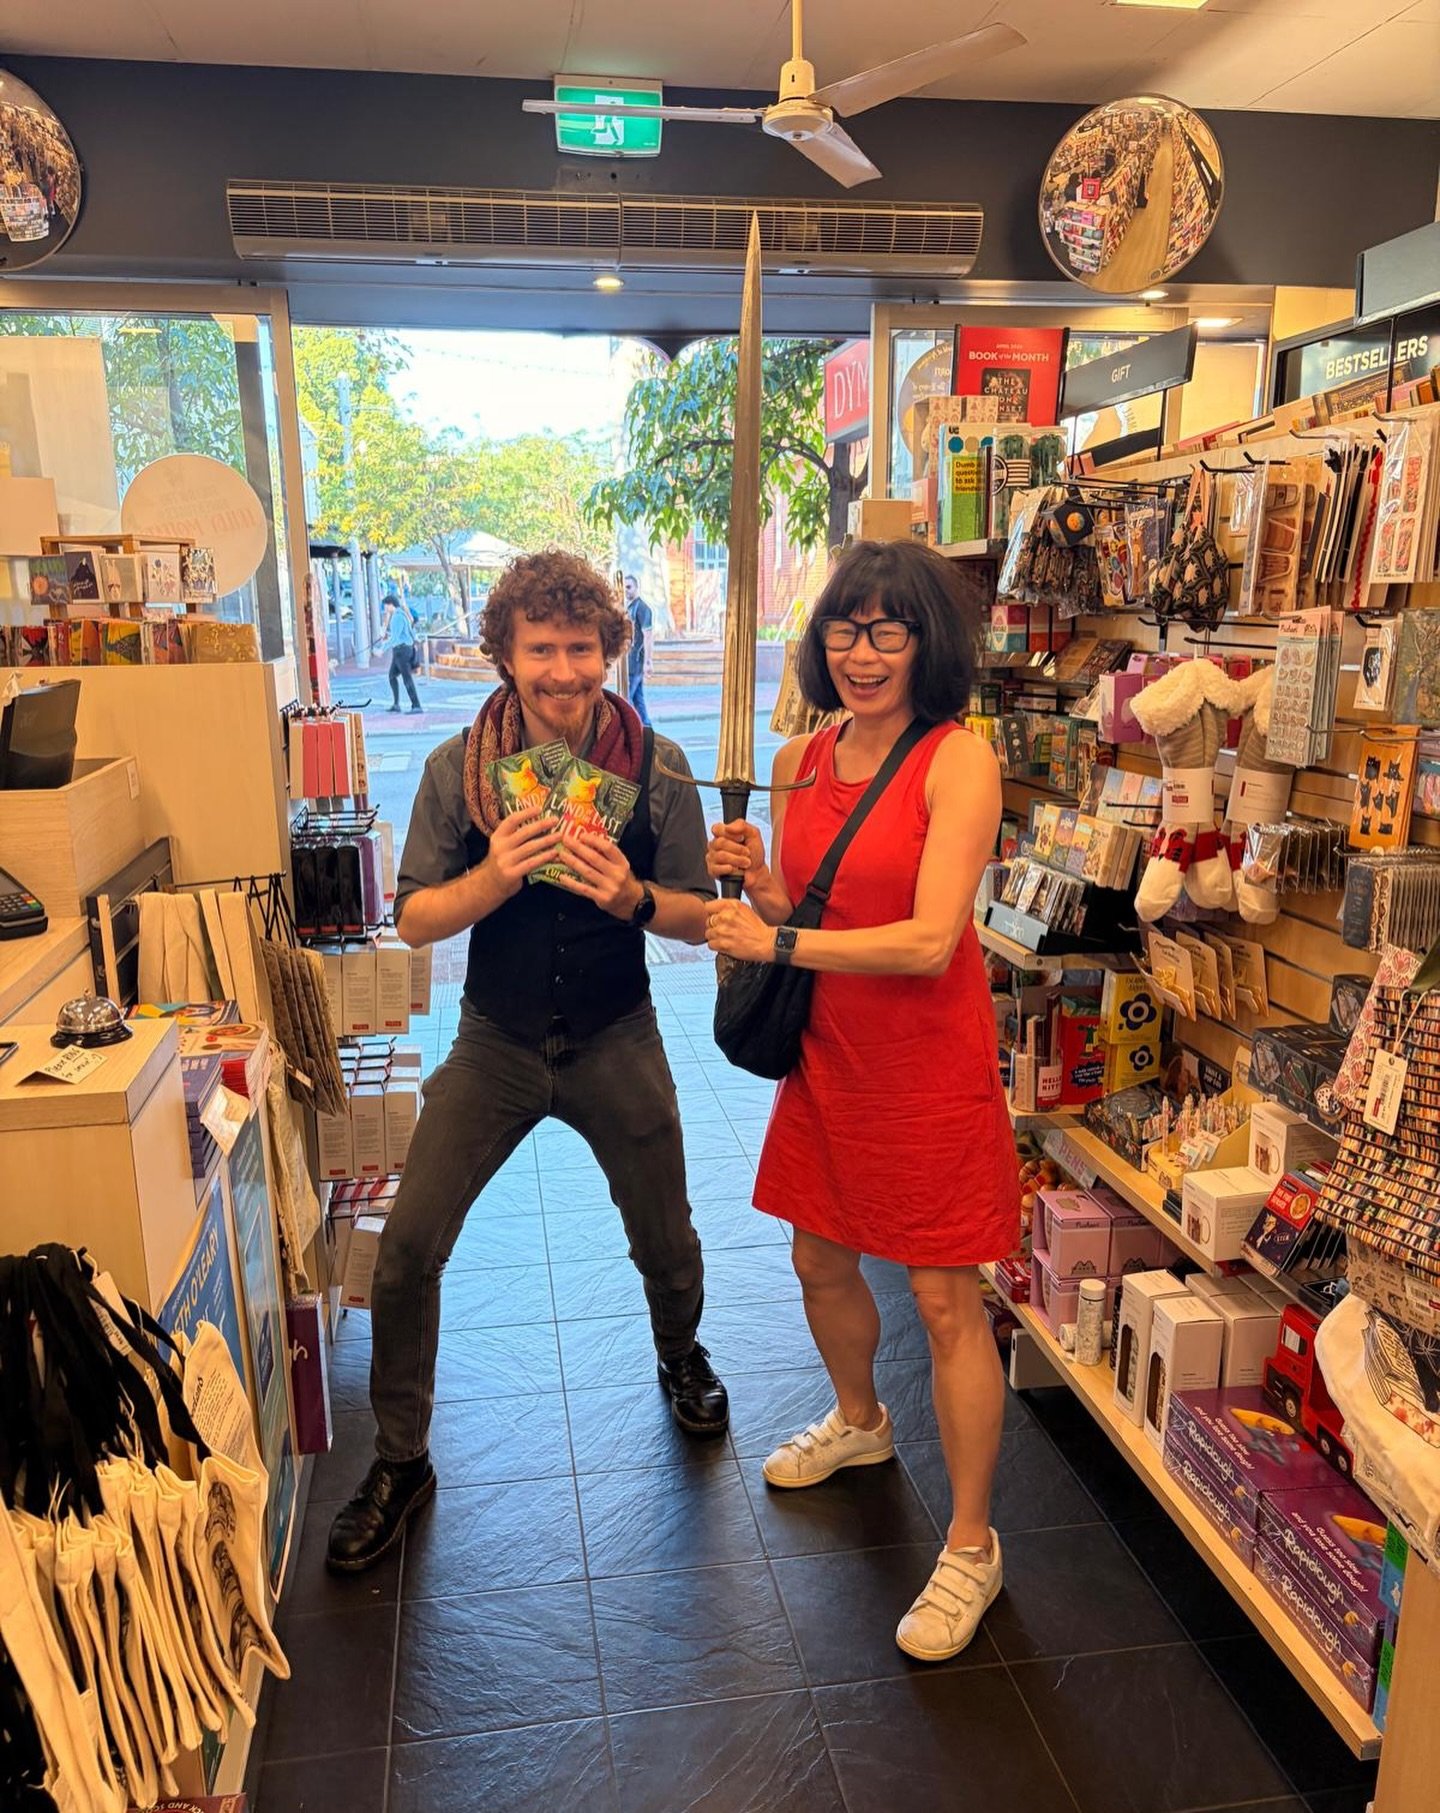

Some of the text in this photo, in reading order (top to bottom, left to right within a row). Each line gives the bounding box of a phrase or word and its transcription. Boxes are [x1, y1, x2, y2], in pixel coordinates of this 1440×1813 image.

[968, 351, 998, 360] BOOK
[1012, 352, 1049, 362] MONTH
[998, 377, 1016, 386] THE
[1111, 364, 1131, 383] GIFT
[1325, 335, 1428, 380] BESTSELERS
[551, 793, 585, 820] LAND
[592, 811, 622, 834] LAST
[190, 1222, 220, 1308] O'LEARY
[1187, 1420, 1235, 1482] Rapidough
[1182, 1459, 1231, 1522] Rapidough
[1283, 1527, 1346, 1605] Rapidough
[1291, 1511, 1369, 1593] and you lose some dough!
[1316, 1526, 1363, 1576] Guess too slow
[1281, 1573, 1343, 1654] Rapidough
[167, 1801, 191, 1810] AND
